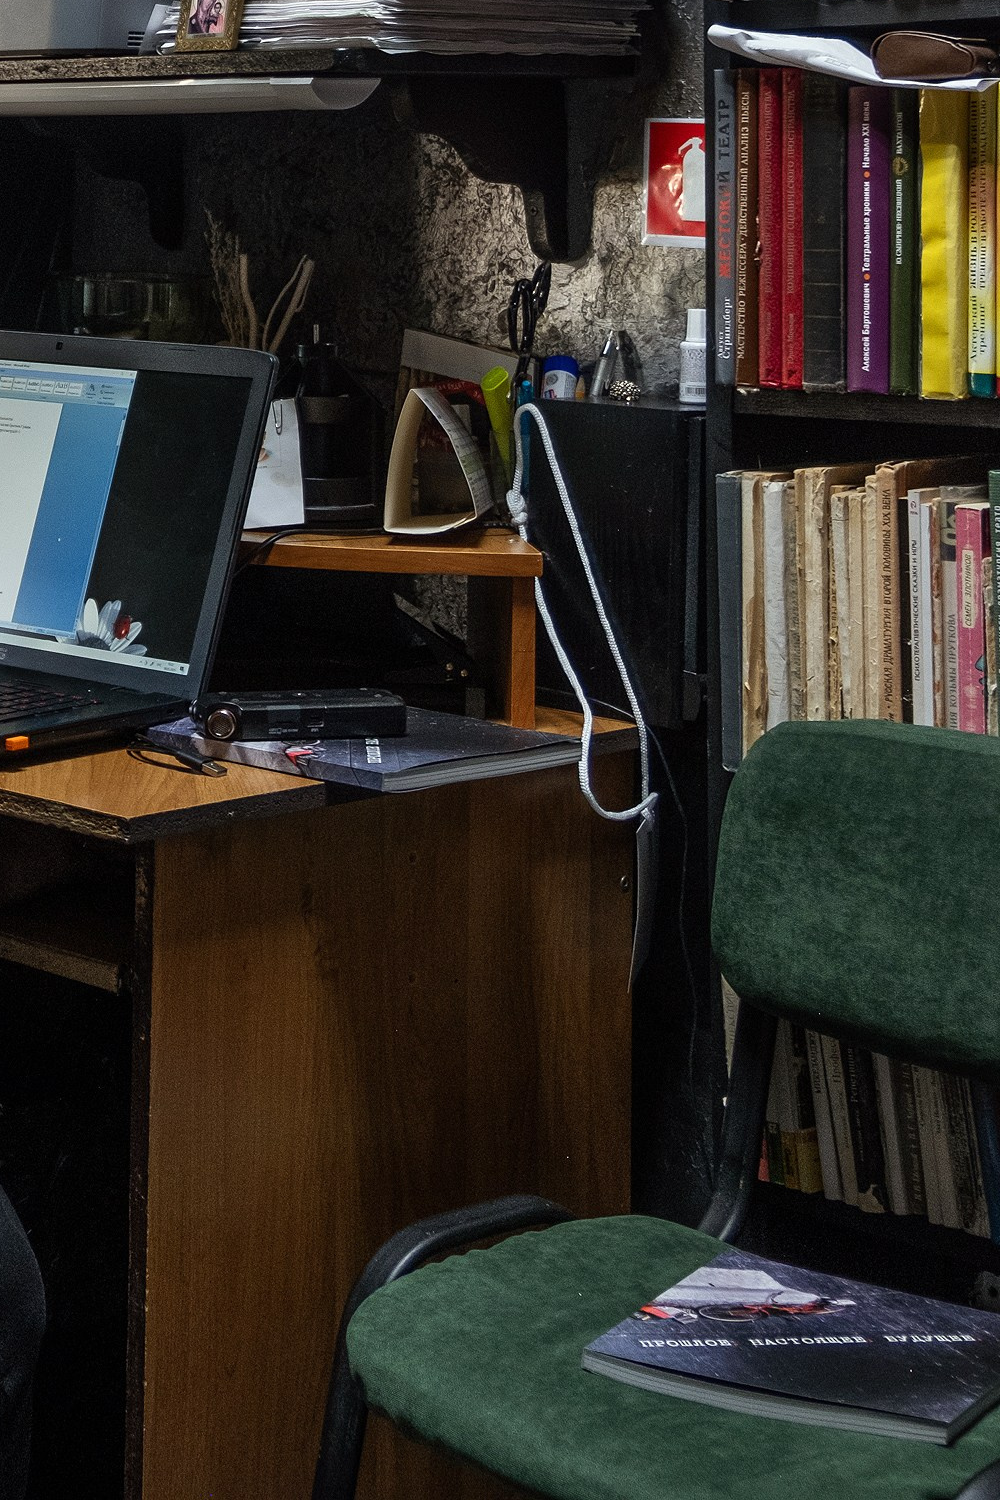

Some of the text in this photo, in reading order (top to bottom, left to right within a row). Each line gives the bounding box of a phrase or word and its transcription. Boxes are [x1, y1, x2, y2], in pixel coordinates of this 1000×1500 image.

[862, 124, 870, 136] XXI
[862, 138, 870, 168] Начало
[717, 99, 732, 279] ЖЕСТОКИЙ ТЕАТР
[862, 181, 871, 216] хроники
[737, 91, 750, 359] МАСТЕРСТВО РЕЖИССЕРА ДЕЙСТВЕННЫЙ АНАЛИЗ ПЬЕСЫ
[862, 217, 871, 272] Театральные
[862, 283, 870, 334] Бартошевич
[861, 337, 870, 372] Алексей
[882, 511, 891, 527] XIX
[882, 529, 892, 572] ПОЛОВИНЫ
[881, 574, 892, 605] ВТОРОЙ
[964, 601, 972, 626] СЕМЕН
[883, 608, 894, 665] ДРАМАТУРГИЯ
[948, 614, 956, 663] ПРУТКОВА
[949, 668, 957, 708] КОЗЬМЫ
